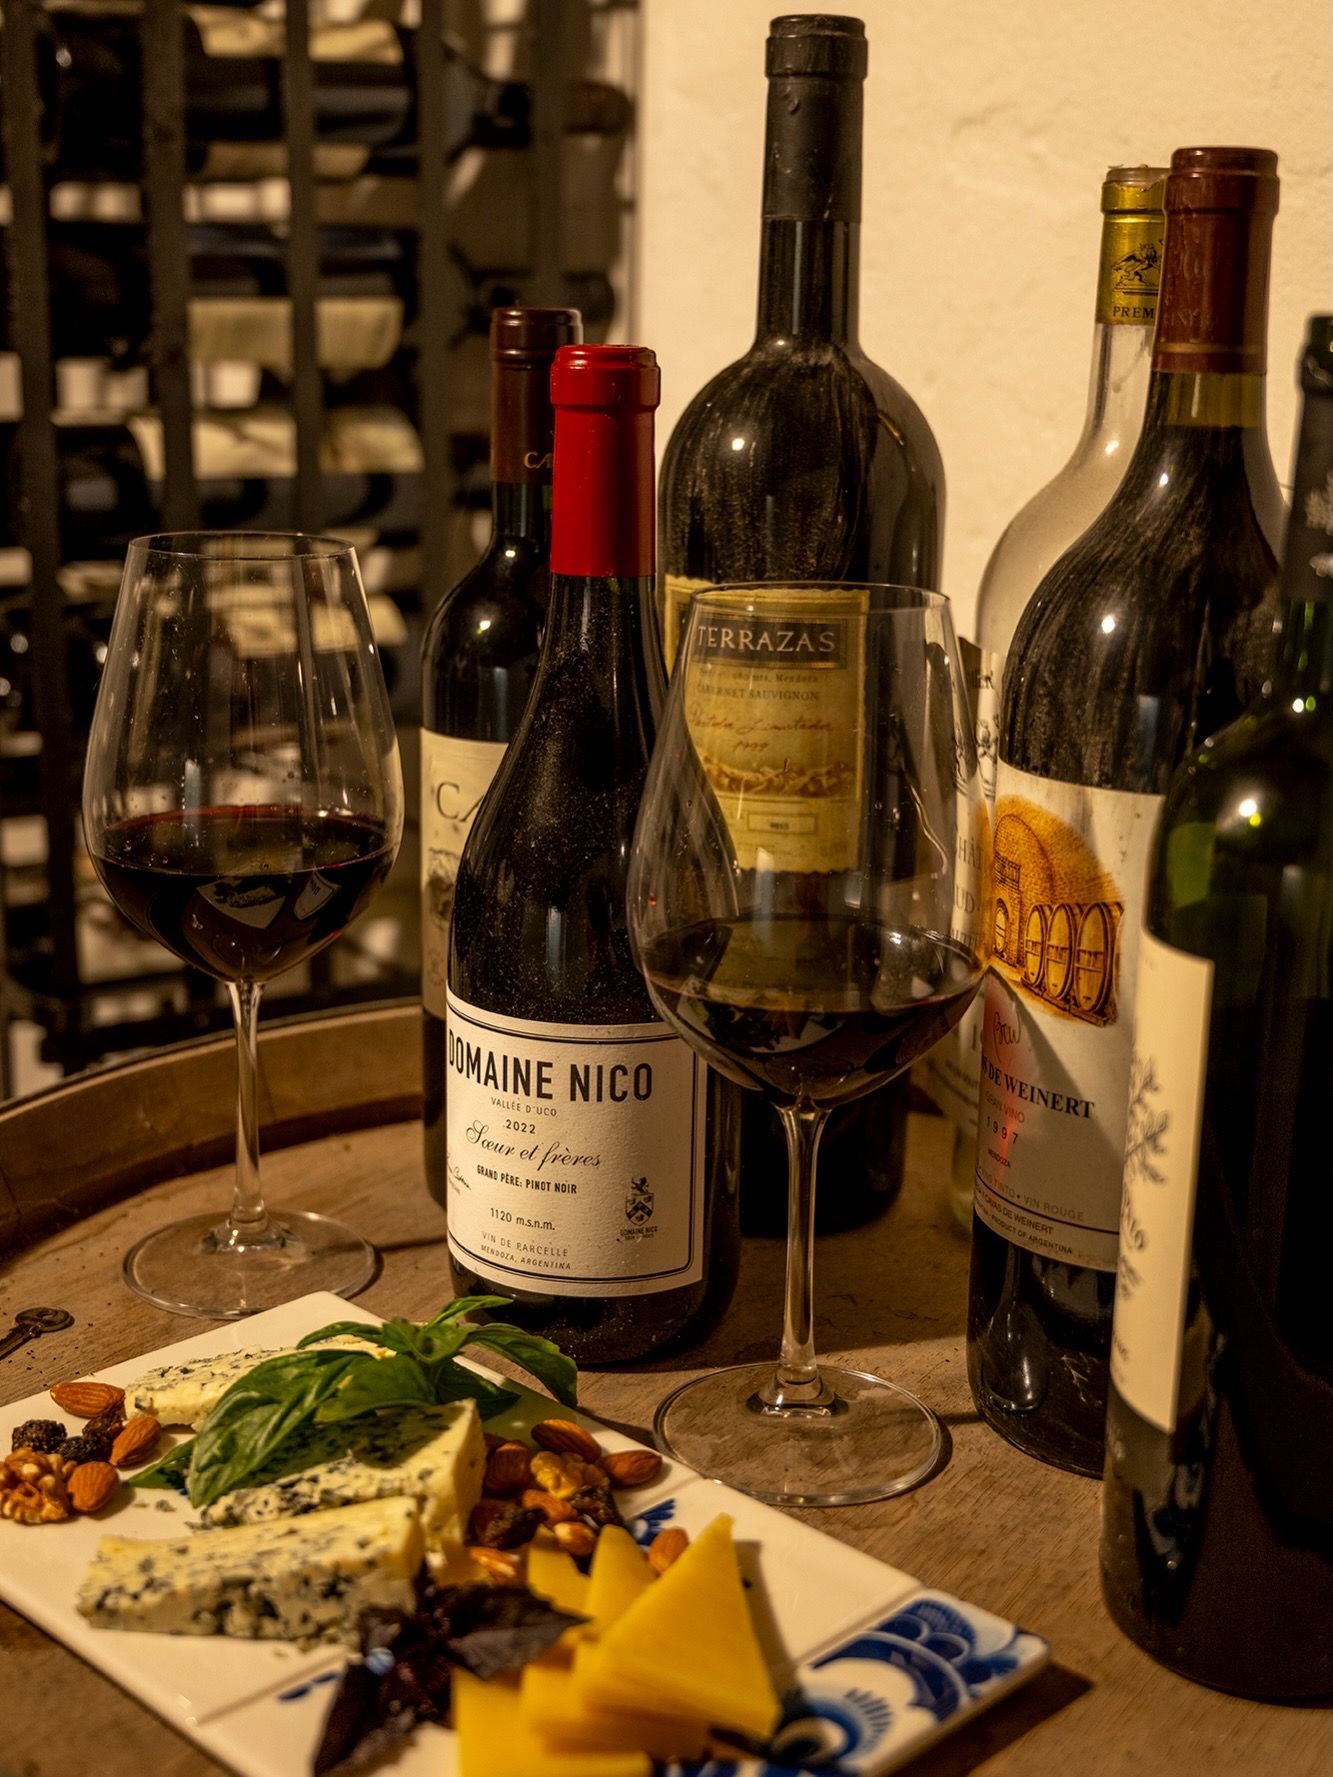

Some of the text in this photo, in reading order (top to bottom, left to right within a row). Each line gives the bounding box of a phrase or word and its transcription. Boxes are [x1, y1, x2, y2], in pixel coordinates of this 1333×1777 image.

[698, 625, 836, 653] TERRAZAS
[749, 689, 820, 701] SAUVIGNON
[449, 1028, 653, 1102] DOMAINE NICO
[988, 1061, 1002, 1087] DE
[1004, 1073, 1095, 1119] WEINERT
[491, 1096, 557, 1117] VALLÉE D'UCO
[506, 1119, 536, 1134] 2022
[986, 1116, 1018, 1144] 1997
[465, 1120, 601, 1171] Sœur et frères
[477, 1164, 498, 1181] GRAND
[500, 1171, 522, 1187] PÈRE:
[525, 1179, 551, 1192] PINOT
[554, 1183, 577, 1194] NOIR
[1024, 1195, 1040, 1209] VIN
[490, 1207, 556, 1231] 1120 m.s.n.m.
[1014, 1214, 1055, 1235] WEINERT
[481, 1231, 568, 1257] VIN DE PARCELLE
[1017, 1230, 1027, 1238] OF
[1028, 1235, 1072, 1254] ARGENTINA
[520, 1257, 571, 1270] ARGENTINA
